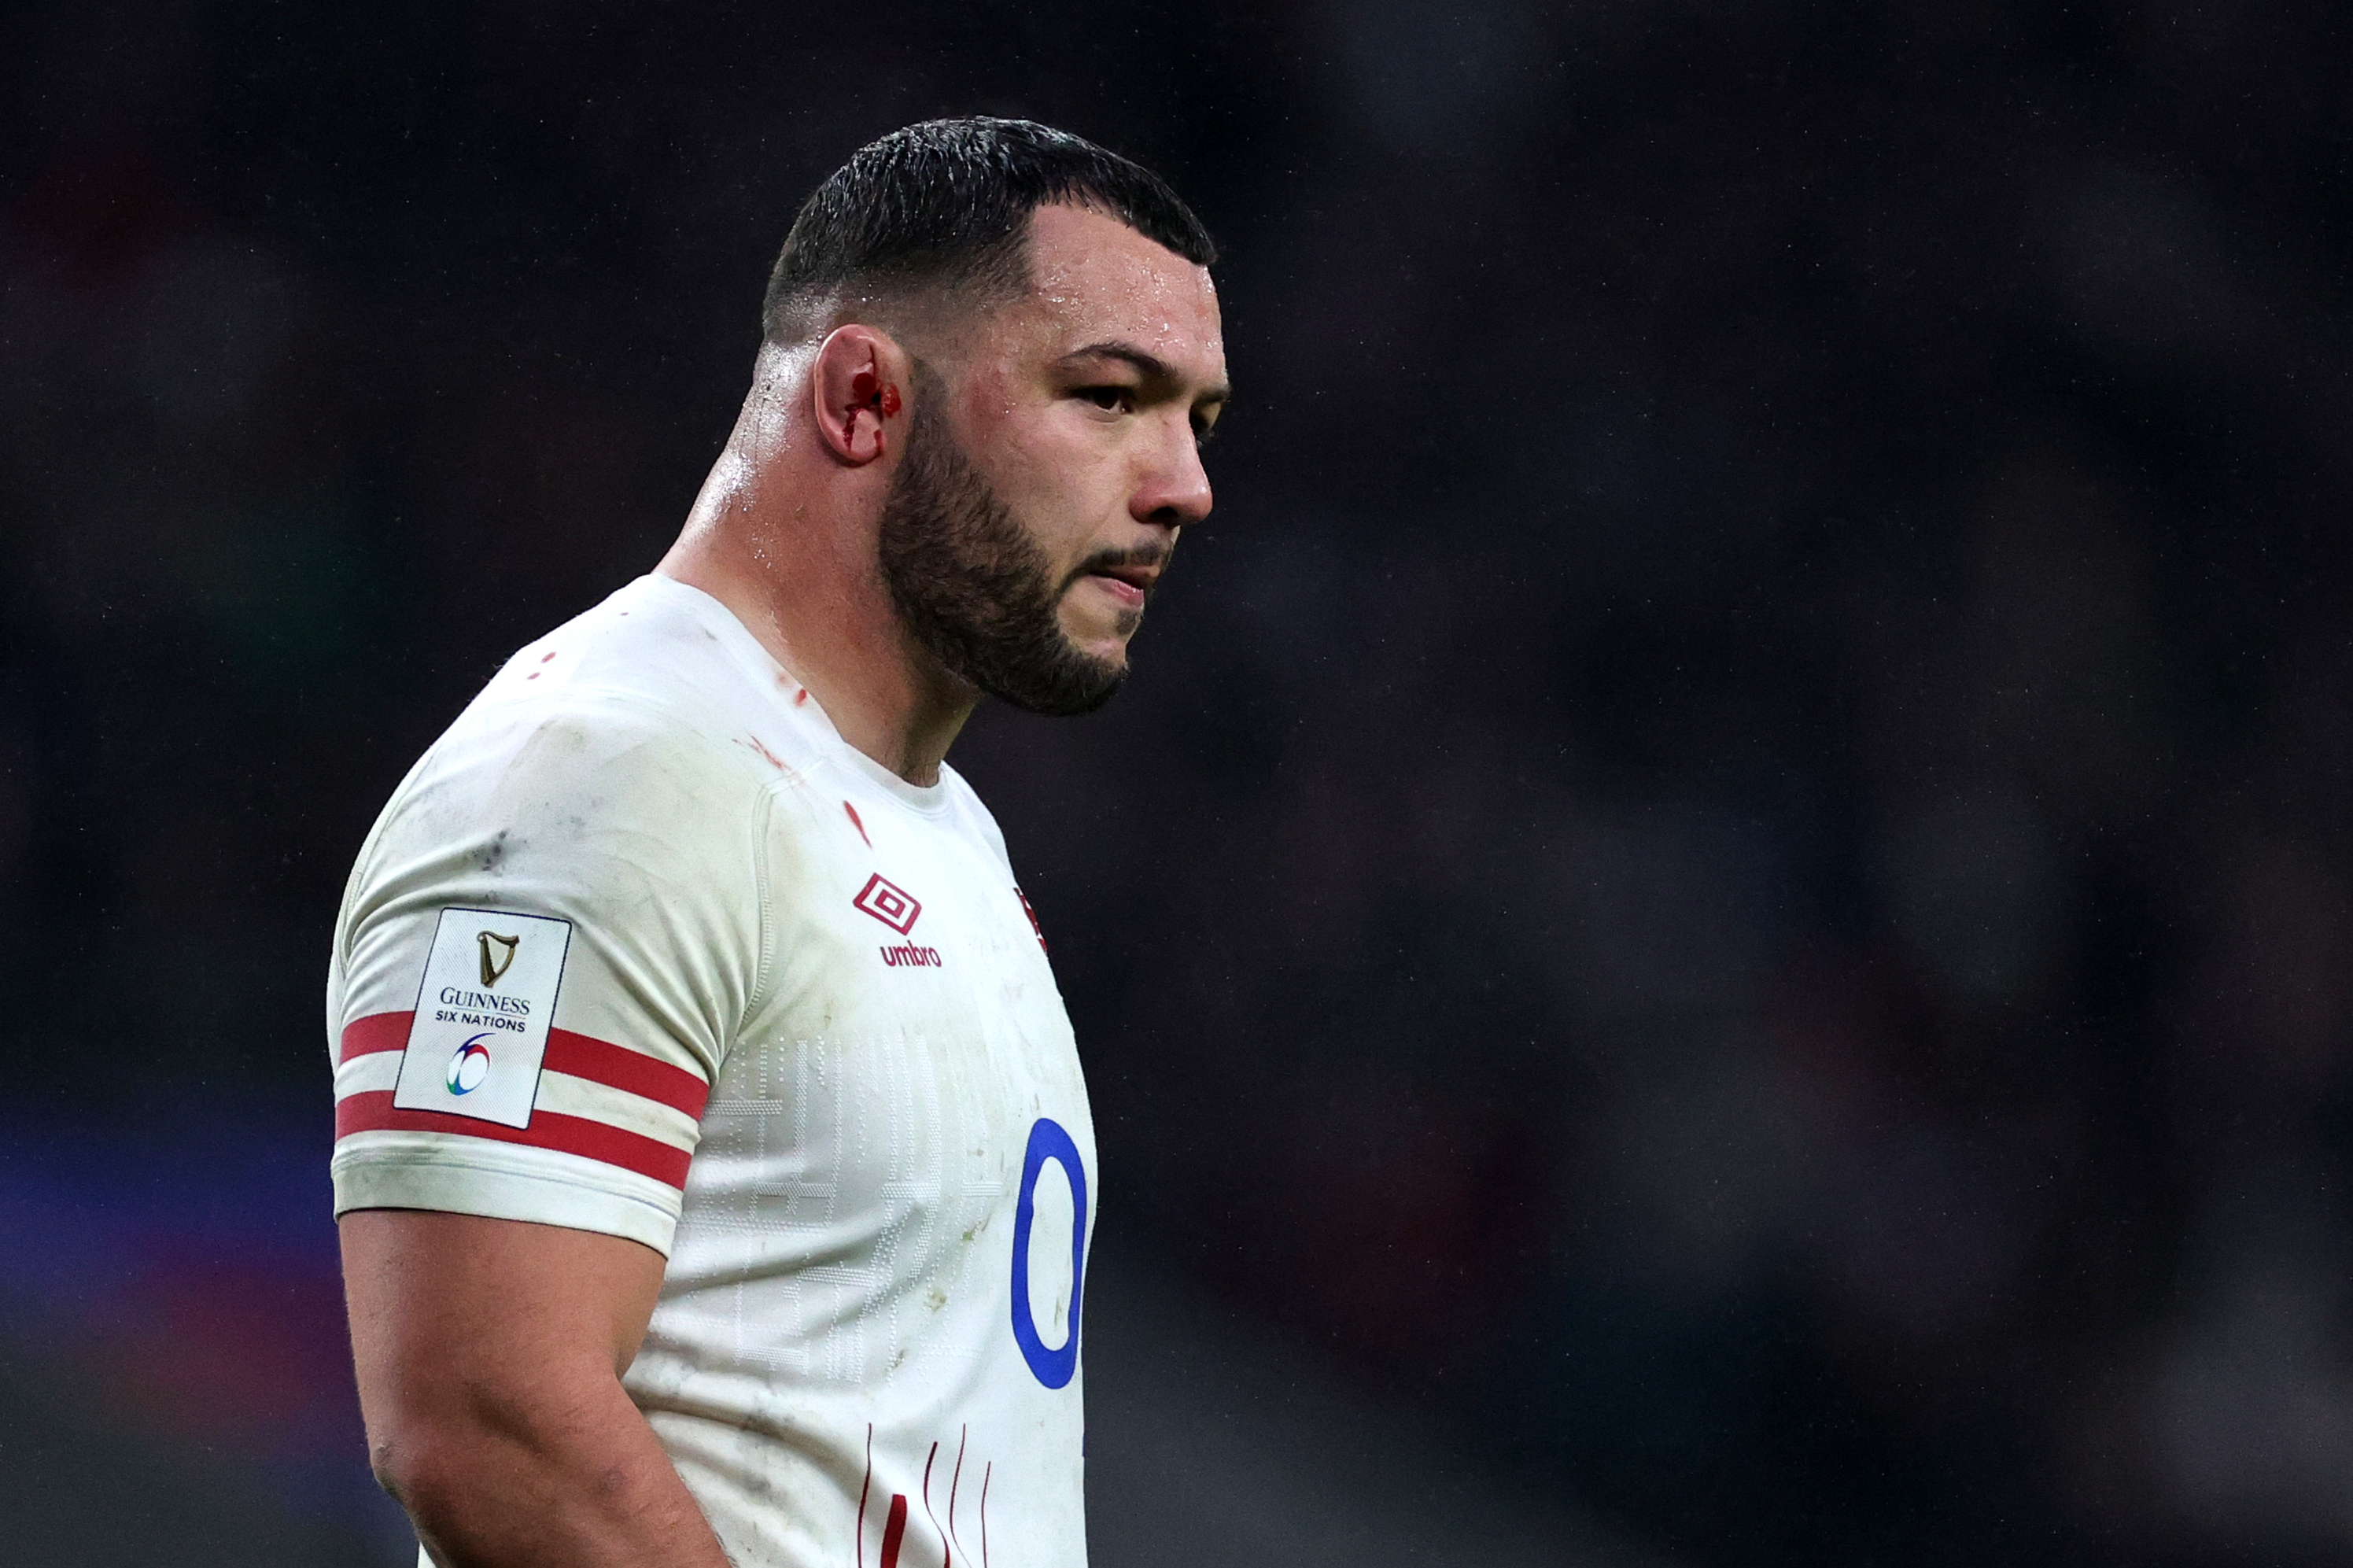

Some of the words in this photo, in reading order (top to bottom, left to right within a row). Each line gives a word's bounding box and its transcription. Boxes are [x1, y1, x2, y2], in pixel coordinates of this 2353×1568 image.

[880, 940, 942, 967] umbro
[440, 987, 530, 1015] GUINNESS
[435, 1010, 458, 1022] SIX
[461, 1013, 526, 1032] NATIONS
